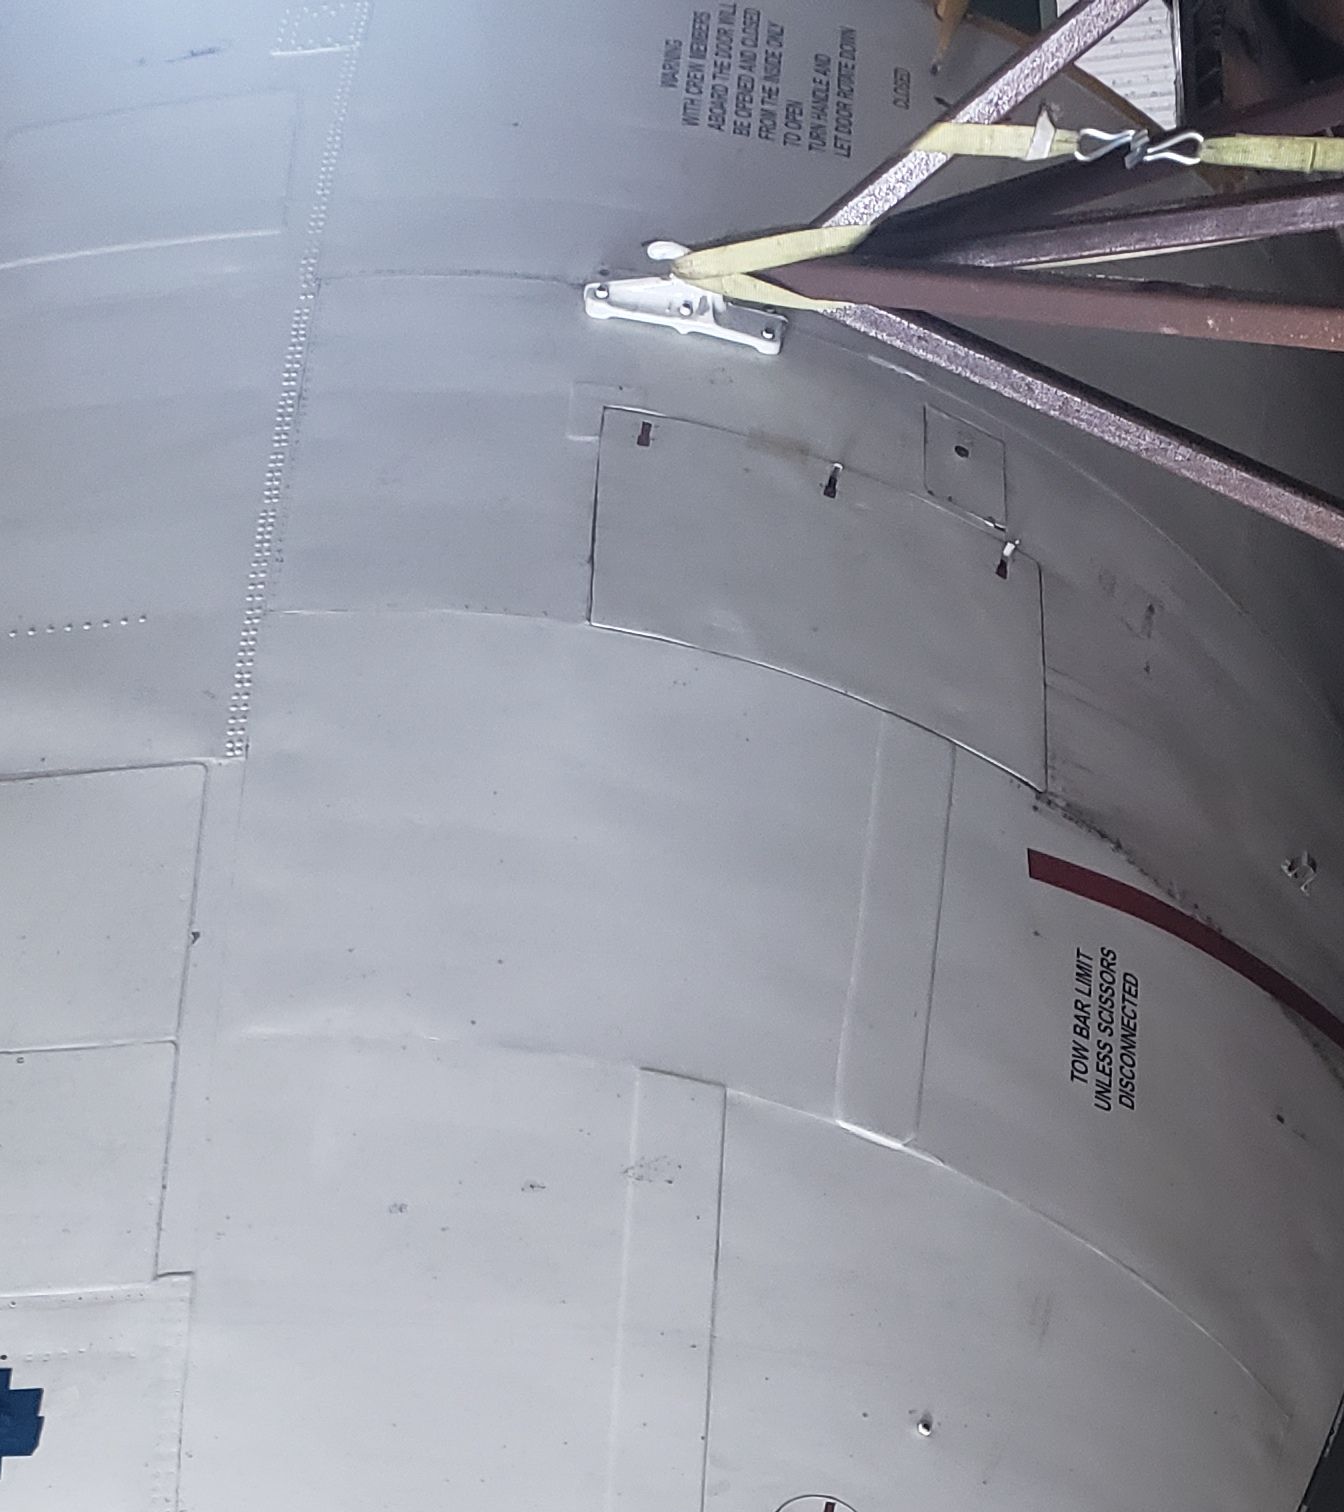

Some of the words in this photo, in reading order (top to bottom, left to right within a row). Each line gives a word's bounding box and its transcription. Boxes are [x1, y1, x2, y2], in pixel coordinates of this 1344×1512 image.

[718, 3, 737, 26] WILL
[741, 8, 760, 48] CLOSED
[689, 10, 711, 60] MEMBERS
[714, 28, 735, 60] DOOR
[766, 20, 784, 48] ONLY
[839, 25, 857, 61] DOWN
[661, 40, 683, 88] WARNING
[686, 62, 705, 95] CREW
[712, 59, 732, 81] THE
[738, 49, 757, 73] AND
[763, 49, 782, 84] INSIDE
[814, 53, 831, 77] AND
[734, 74, 755, 118] OPENED
[761, 84, 779, 107] THE
[836, 61, 855, 100] ROTATE
[893, 66, 911, 110] CLOSED
[682, 97, 701, 126] WITH
[707, 83, 729, 132] ABOARD
[784, 100, 803, 131] OPEN
[811, 77, 830, 123] HANDLE
[733, 119, 751, 137] BE
[758, 108, 778, 141] FROM
[835, 100, 854, 136] DOOR
[783, 132, 802, 147] TO
[808, 125, 828, 152] TURN
[834, 135, 851, 159] LET
[1074, 947, 1093, 998] LIMIT
[1097, 946, 1117, 1037] SCISSORS
[1073, 999, 1091, 1041] BAR
[1119, 972, 1139, 1110] DISCONNECTED
[1070, 1040, 1090, 1084] TOW
[1094, 1039, 1114, 1112] UNLESS
